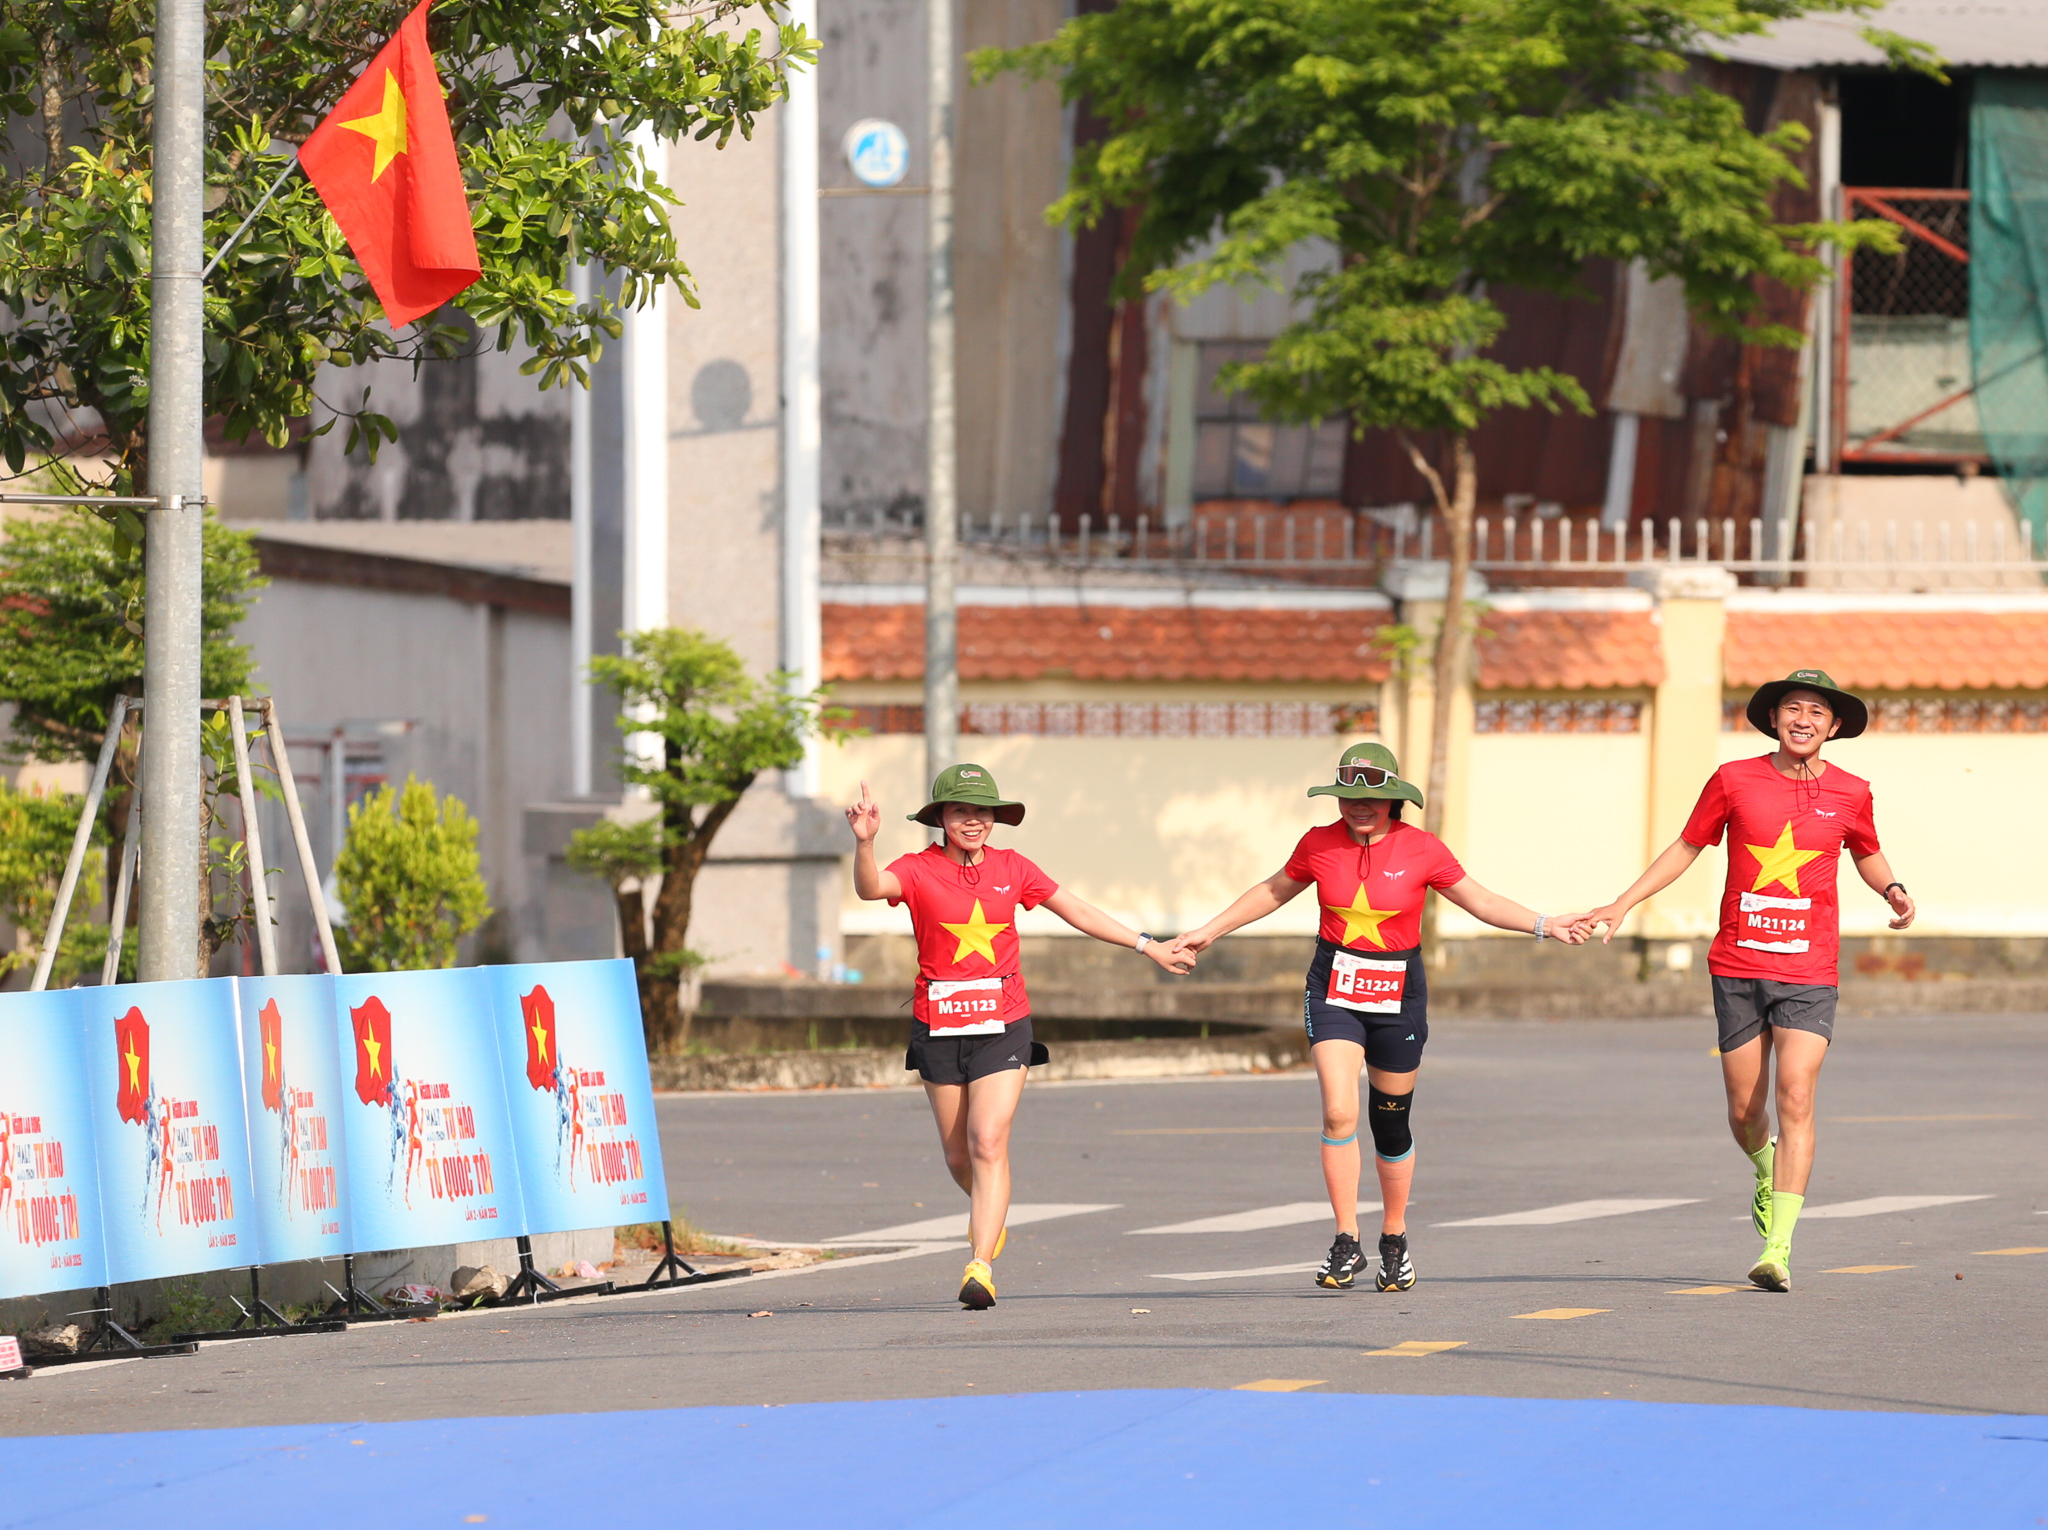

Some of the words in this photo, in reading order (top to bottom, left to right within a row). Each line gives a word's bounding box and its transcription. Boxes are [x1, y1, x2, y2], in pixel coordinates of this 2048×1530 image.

[1748, 913, 1806, 931] M21124
[1342, 974, 1351, 985] F
[1355, 977, 1399, 992] 21224
[938, 999, 997, 1015] M21123
[456, 1101, 475, 1140] HÀO
[610, 1089, 627, 1126] HÀO
[45, 1136, 64, 1178] HÀO
[203, 1120, 219, 1161] HÀO
[586, 1128, 601, 1184] TỔ
[600, 1128, 627, 1187] QUỐC
[425, 1142, 443, 1199] TỔ
[442, 1142, 474, 1202] QUỐC
[15, 1182, 30, 1244] TỔ
[31, 1181, 60, 1248] QUỐC
[175, 1165, 189, 1225] TỔ
[190, 1164, 217, 1228] QUỐC
